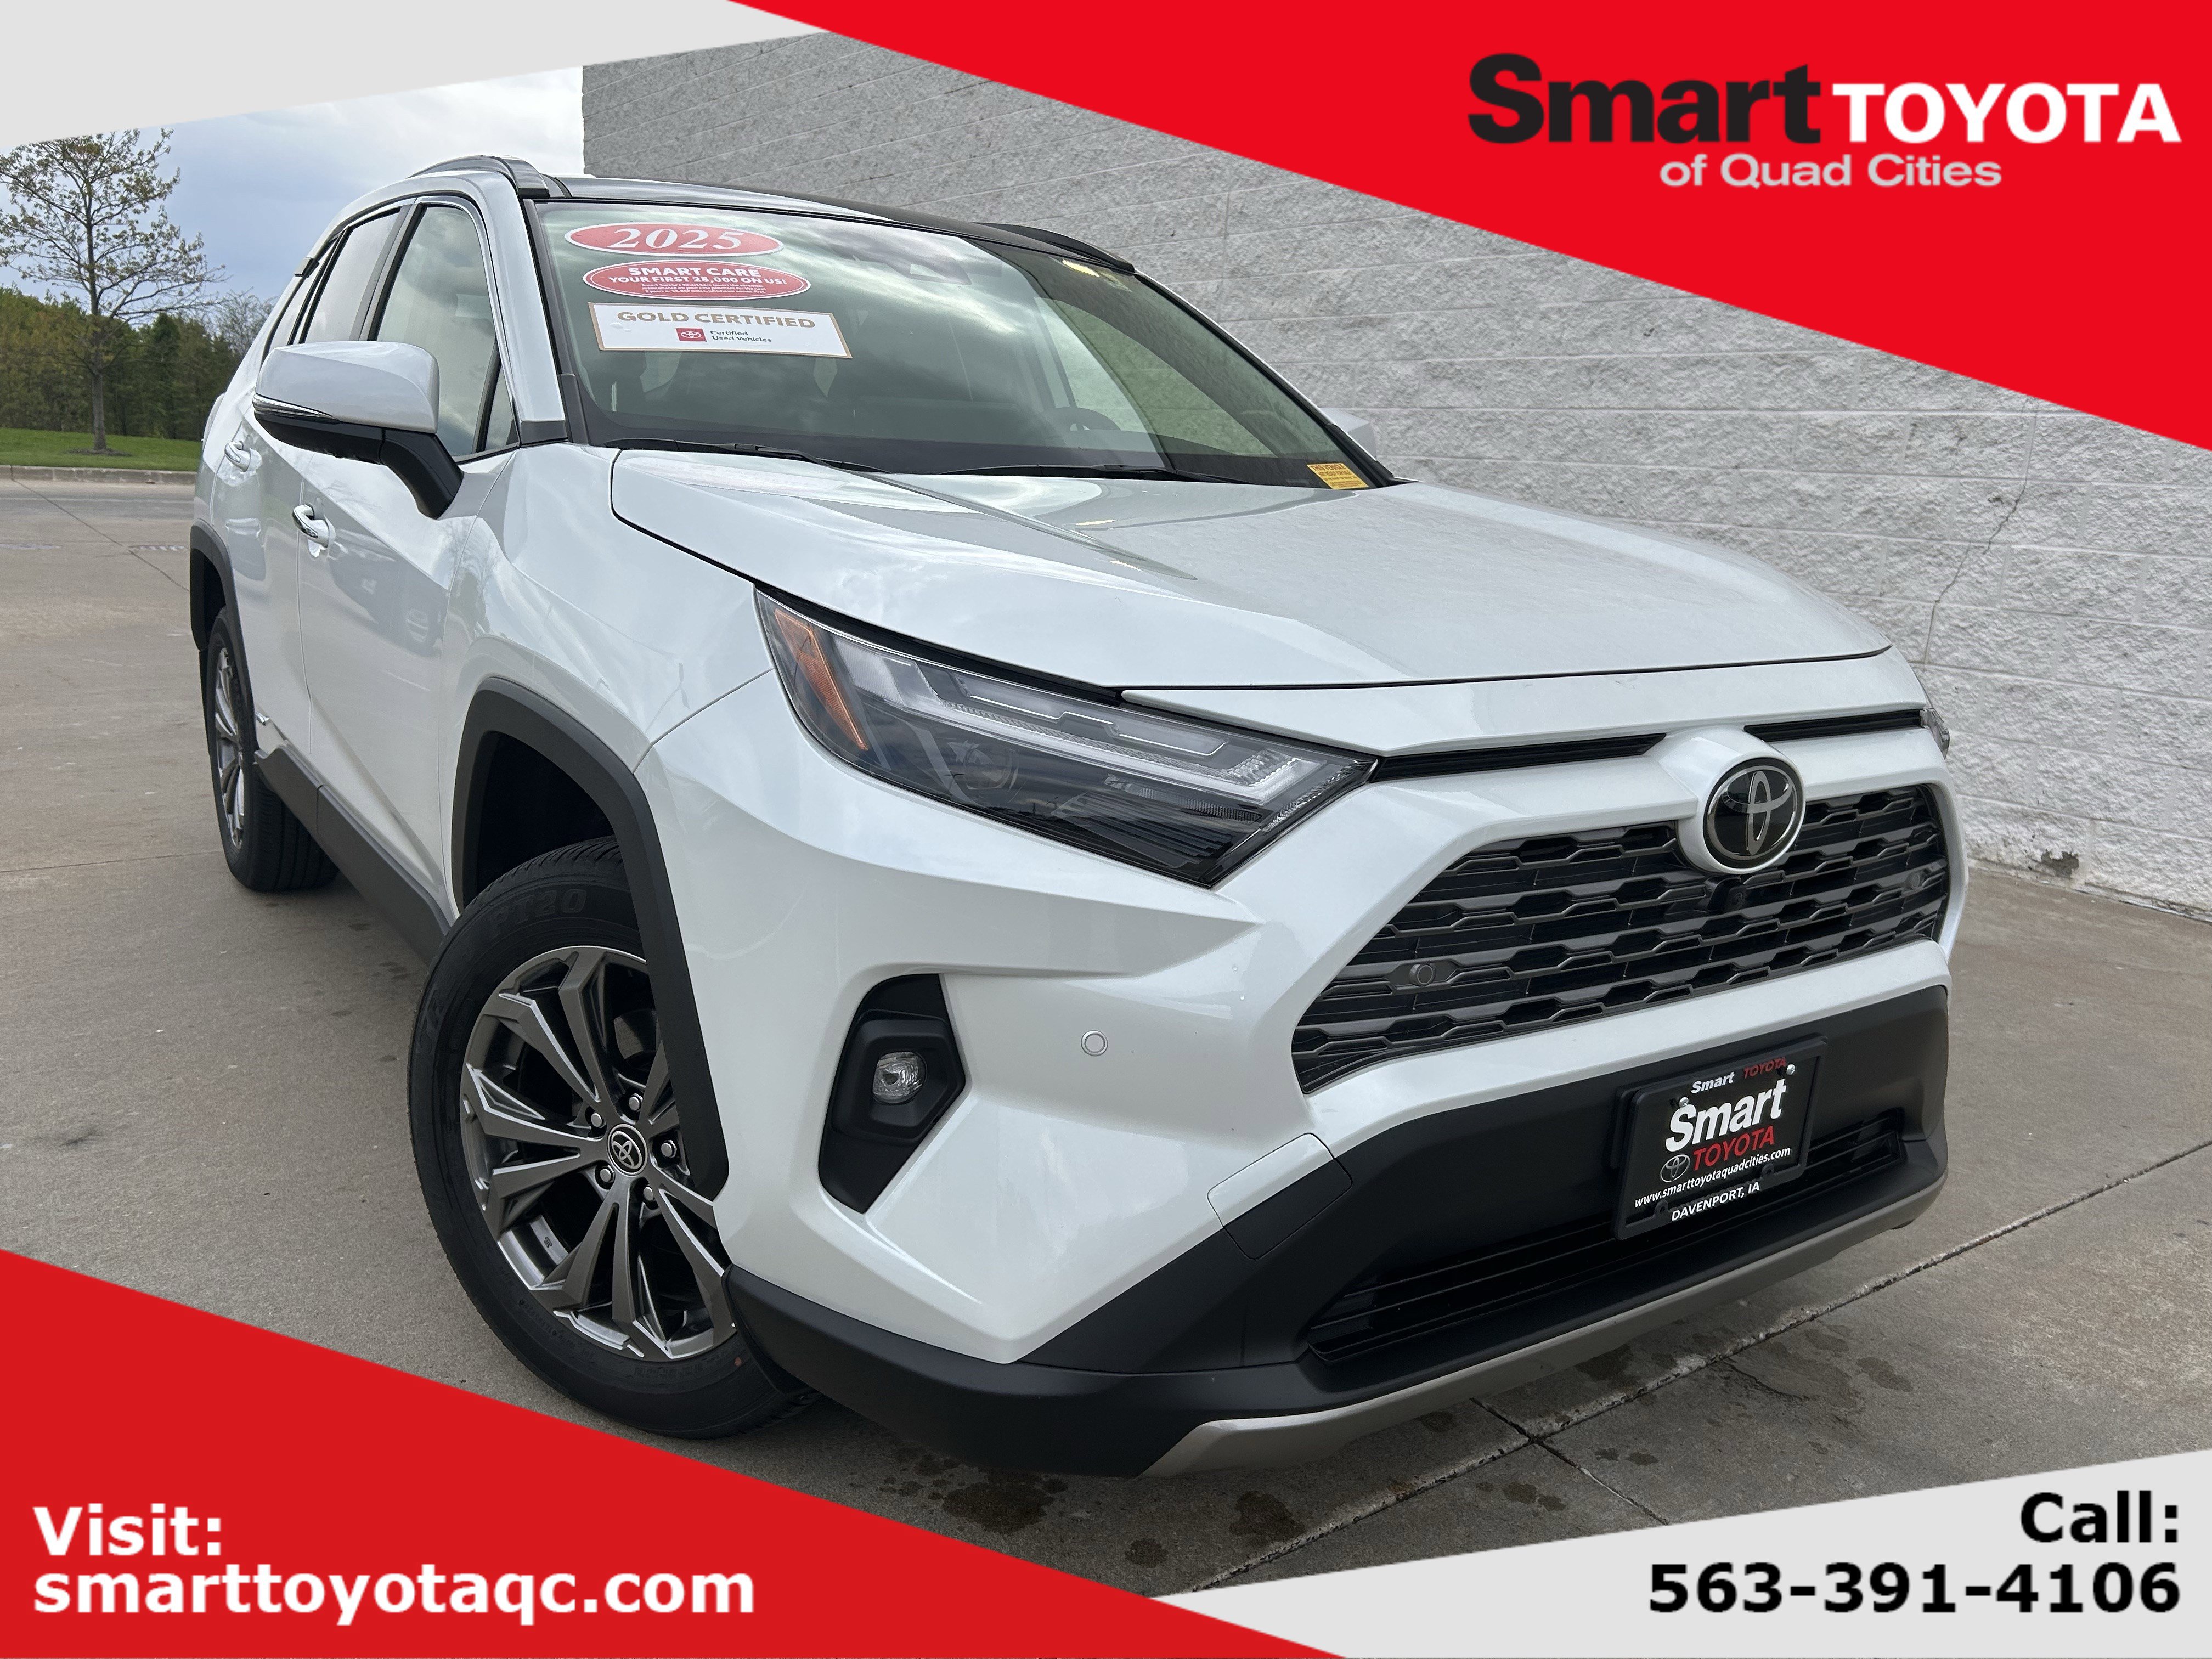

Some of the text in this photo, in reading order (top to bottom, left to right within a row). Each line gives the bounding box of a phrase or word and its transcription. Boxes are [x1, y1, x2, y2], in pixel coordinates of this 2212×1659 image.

[607, 228, 744, 249] 2025
[628, 267, 762, 277] SMART CARE
[617, 312, 815, 328] GOLD CERTIFIED
[1691, 1057, 1787, 1094] Smart TOYOTA
[1666, 1078, 1787, 1152] Smart
[1691, 1125, 1775, 1171] TOYOTA
[1634, 1146, 1791, 1208] www.smarttoyotaquadcities.com
[1671, 1181, 1760, 1221] DAVENPORT, IA
